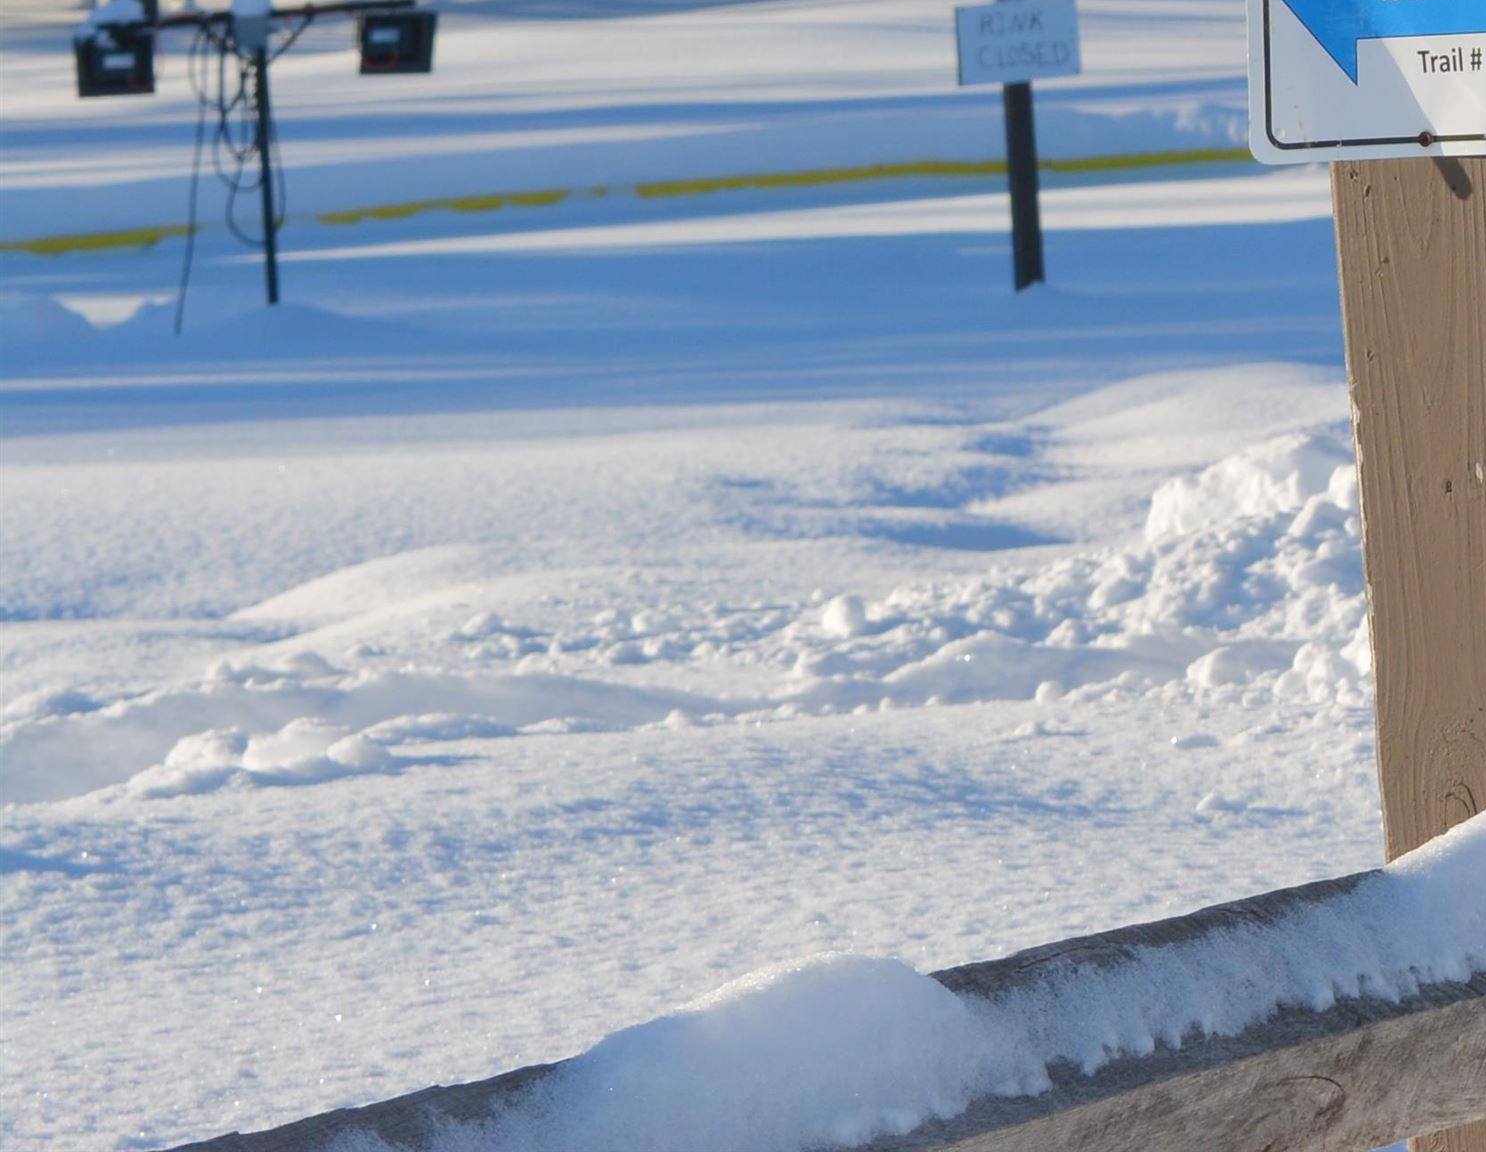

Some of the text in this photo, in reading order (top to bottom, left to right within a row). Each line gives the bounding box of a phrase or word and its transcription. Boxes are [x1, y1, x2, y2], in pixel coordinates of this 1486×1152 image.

[979, 10, 1044, 34] RINK
[976, 41, 1070, 68] CLOSED
[1417, 48, 1464, 74] Trail
[1470, 48, 1484, 71] #
